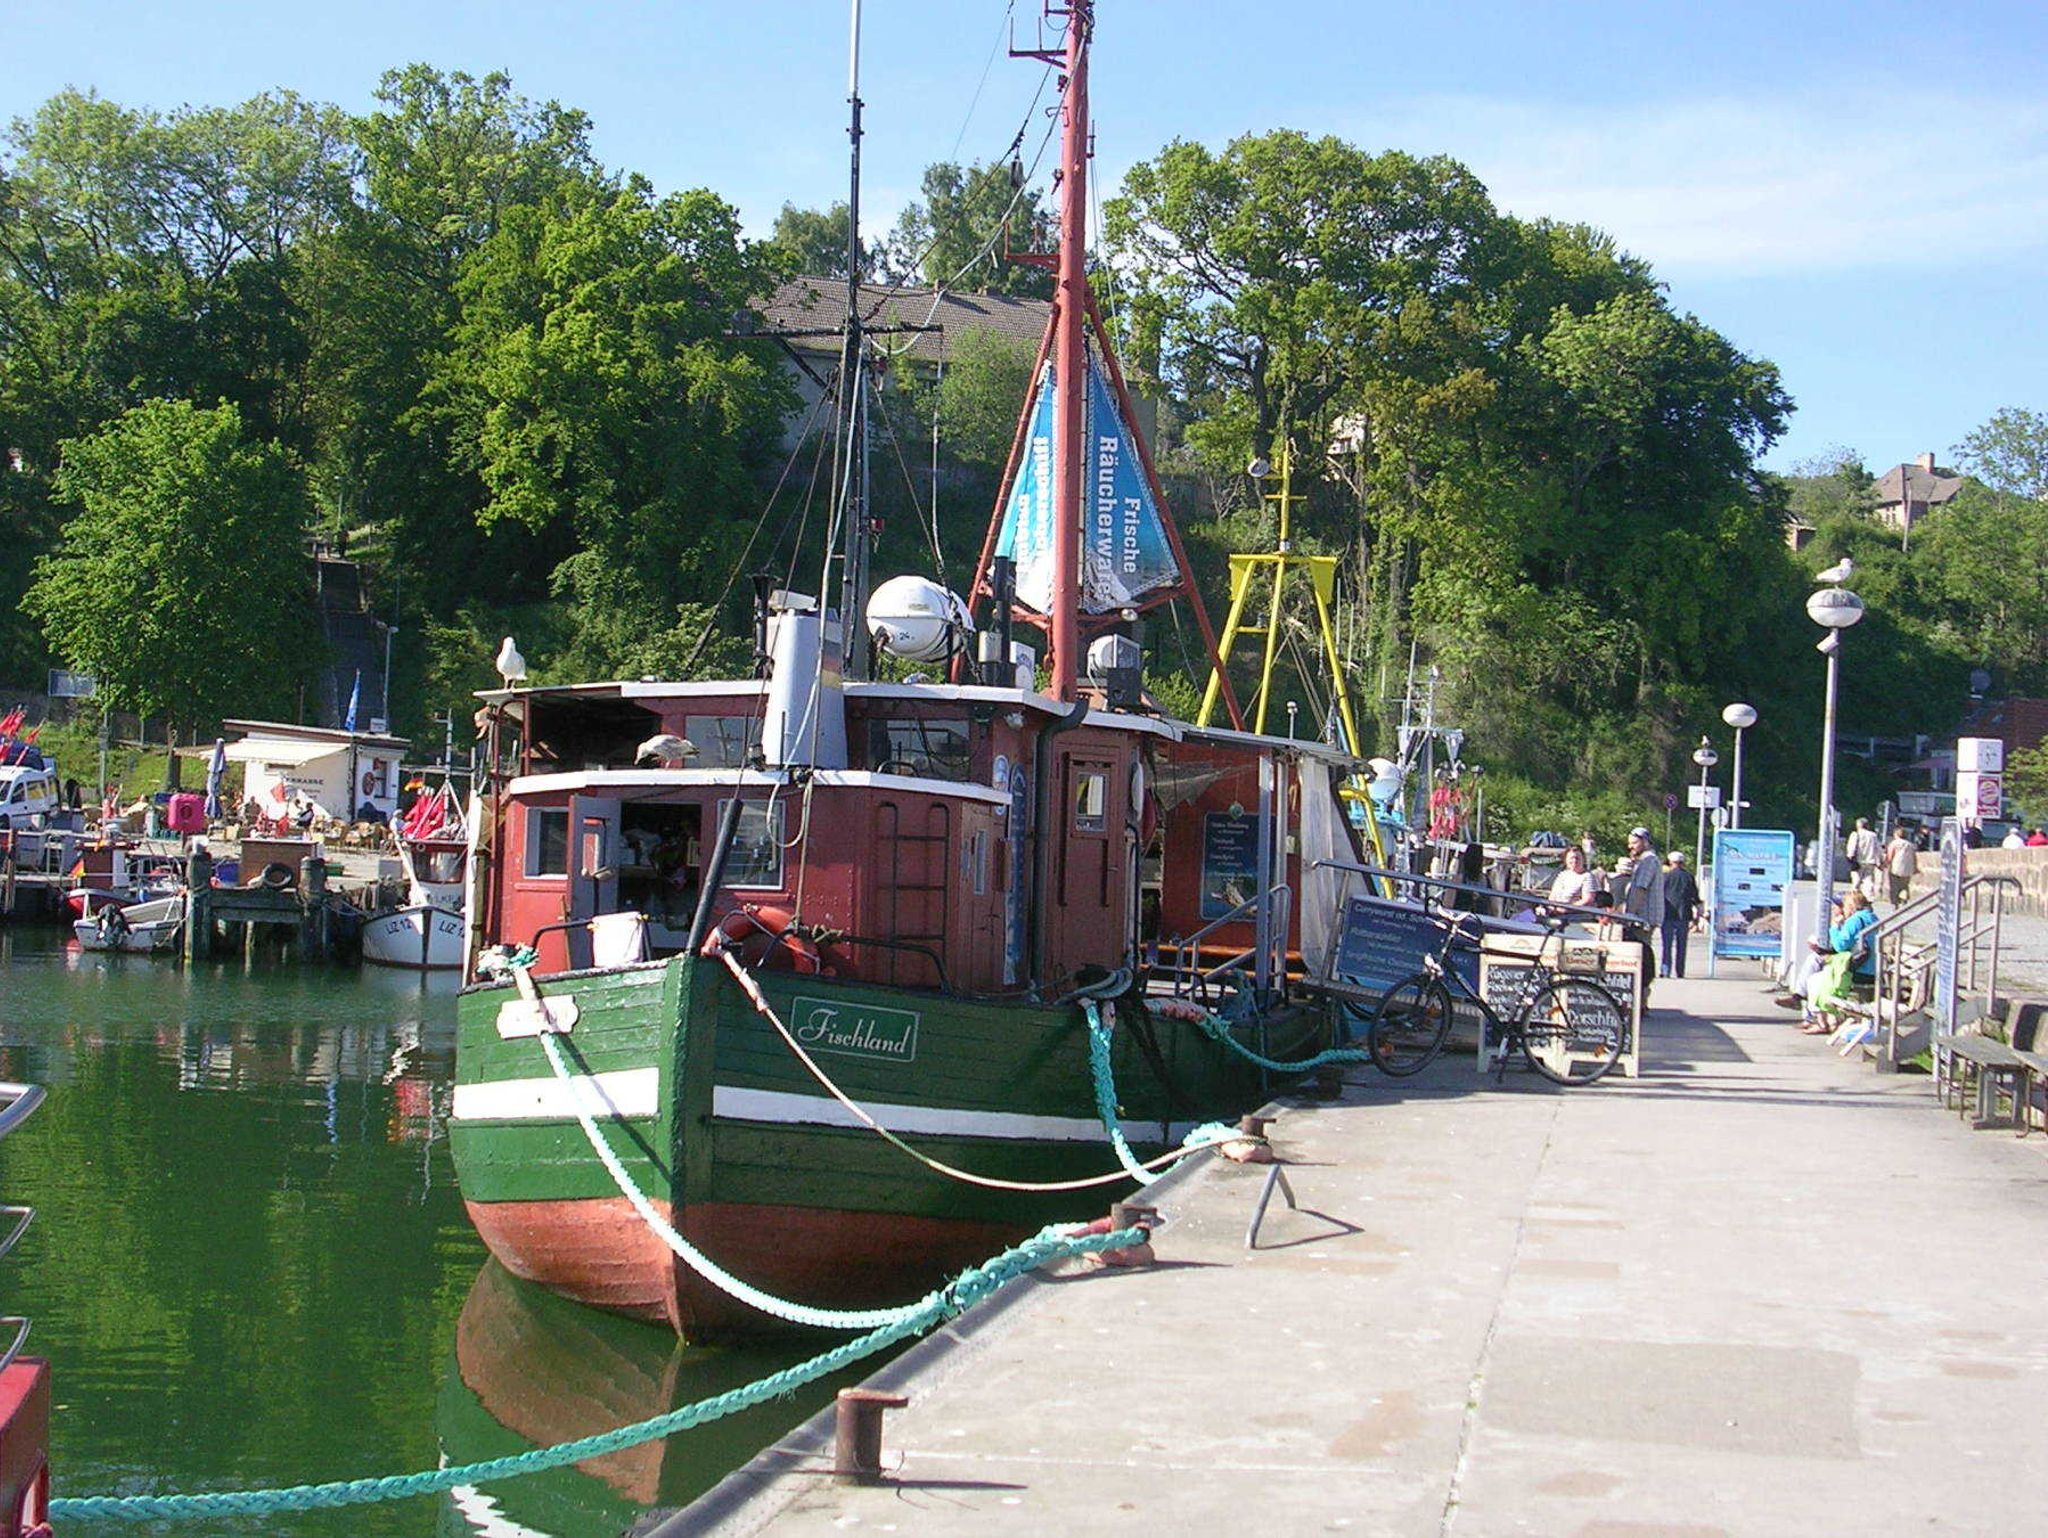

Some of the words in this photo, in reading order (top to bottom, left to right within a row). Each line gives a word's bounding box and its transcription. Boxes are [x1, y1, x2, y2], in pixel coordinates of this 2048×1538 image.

[1097, 436, 1118, 595] Räucherware
[1123, 497, 1141, 574] Frische
[798, 1009, 911, 1052] Fischland
